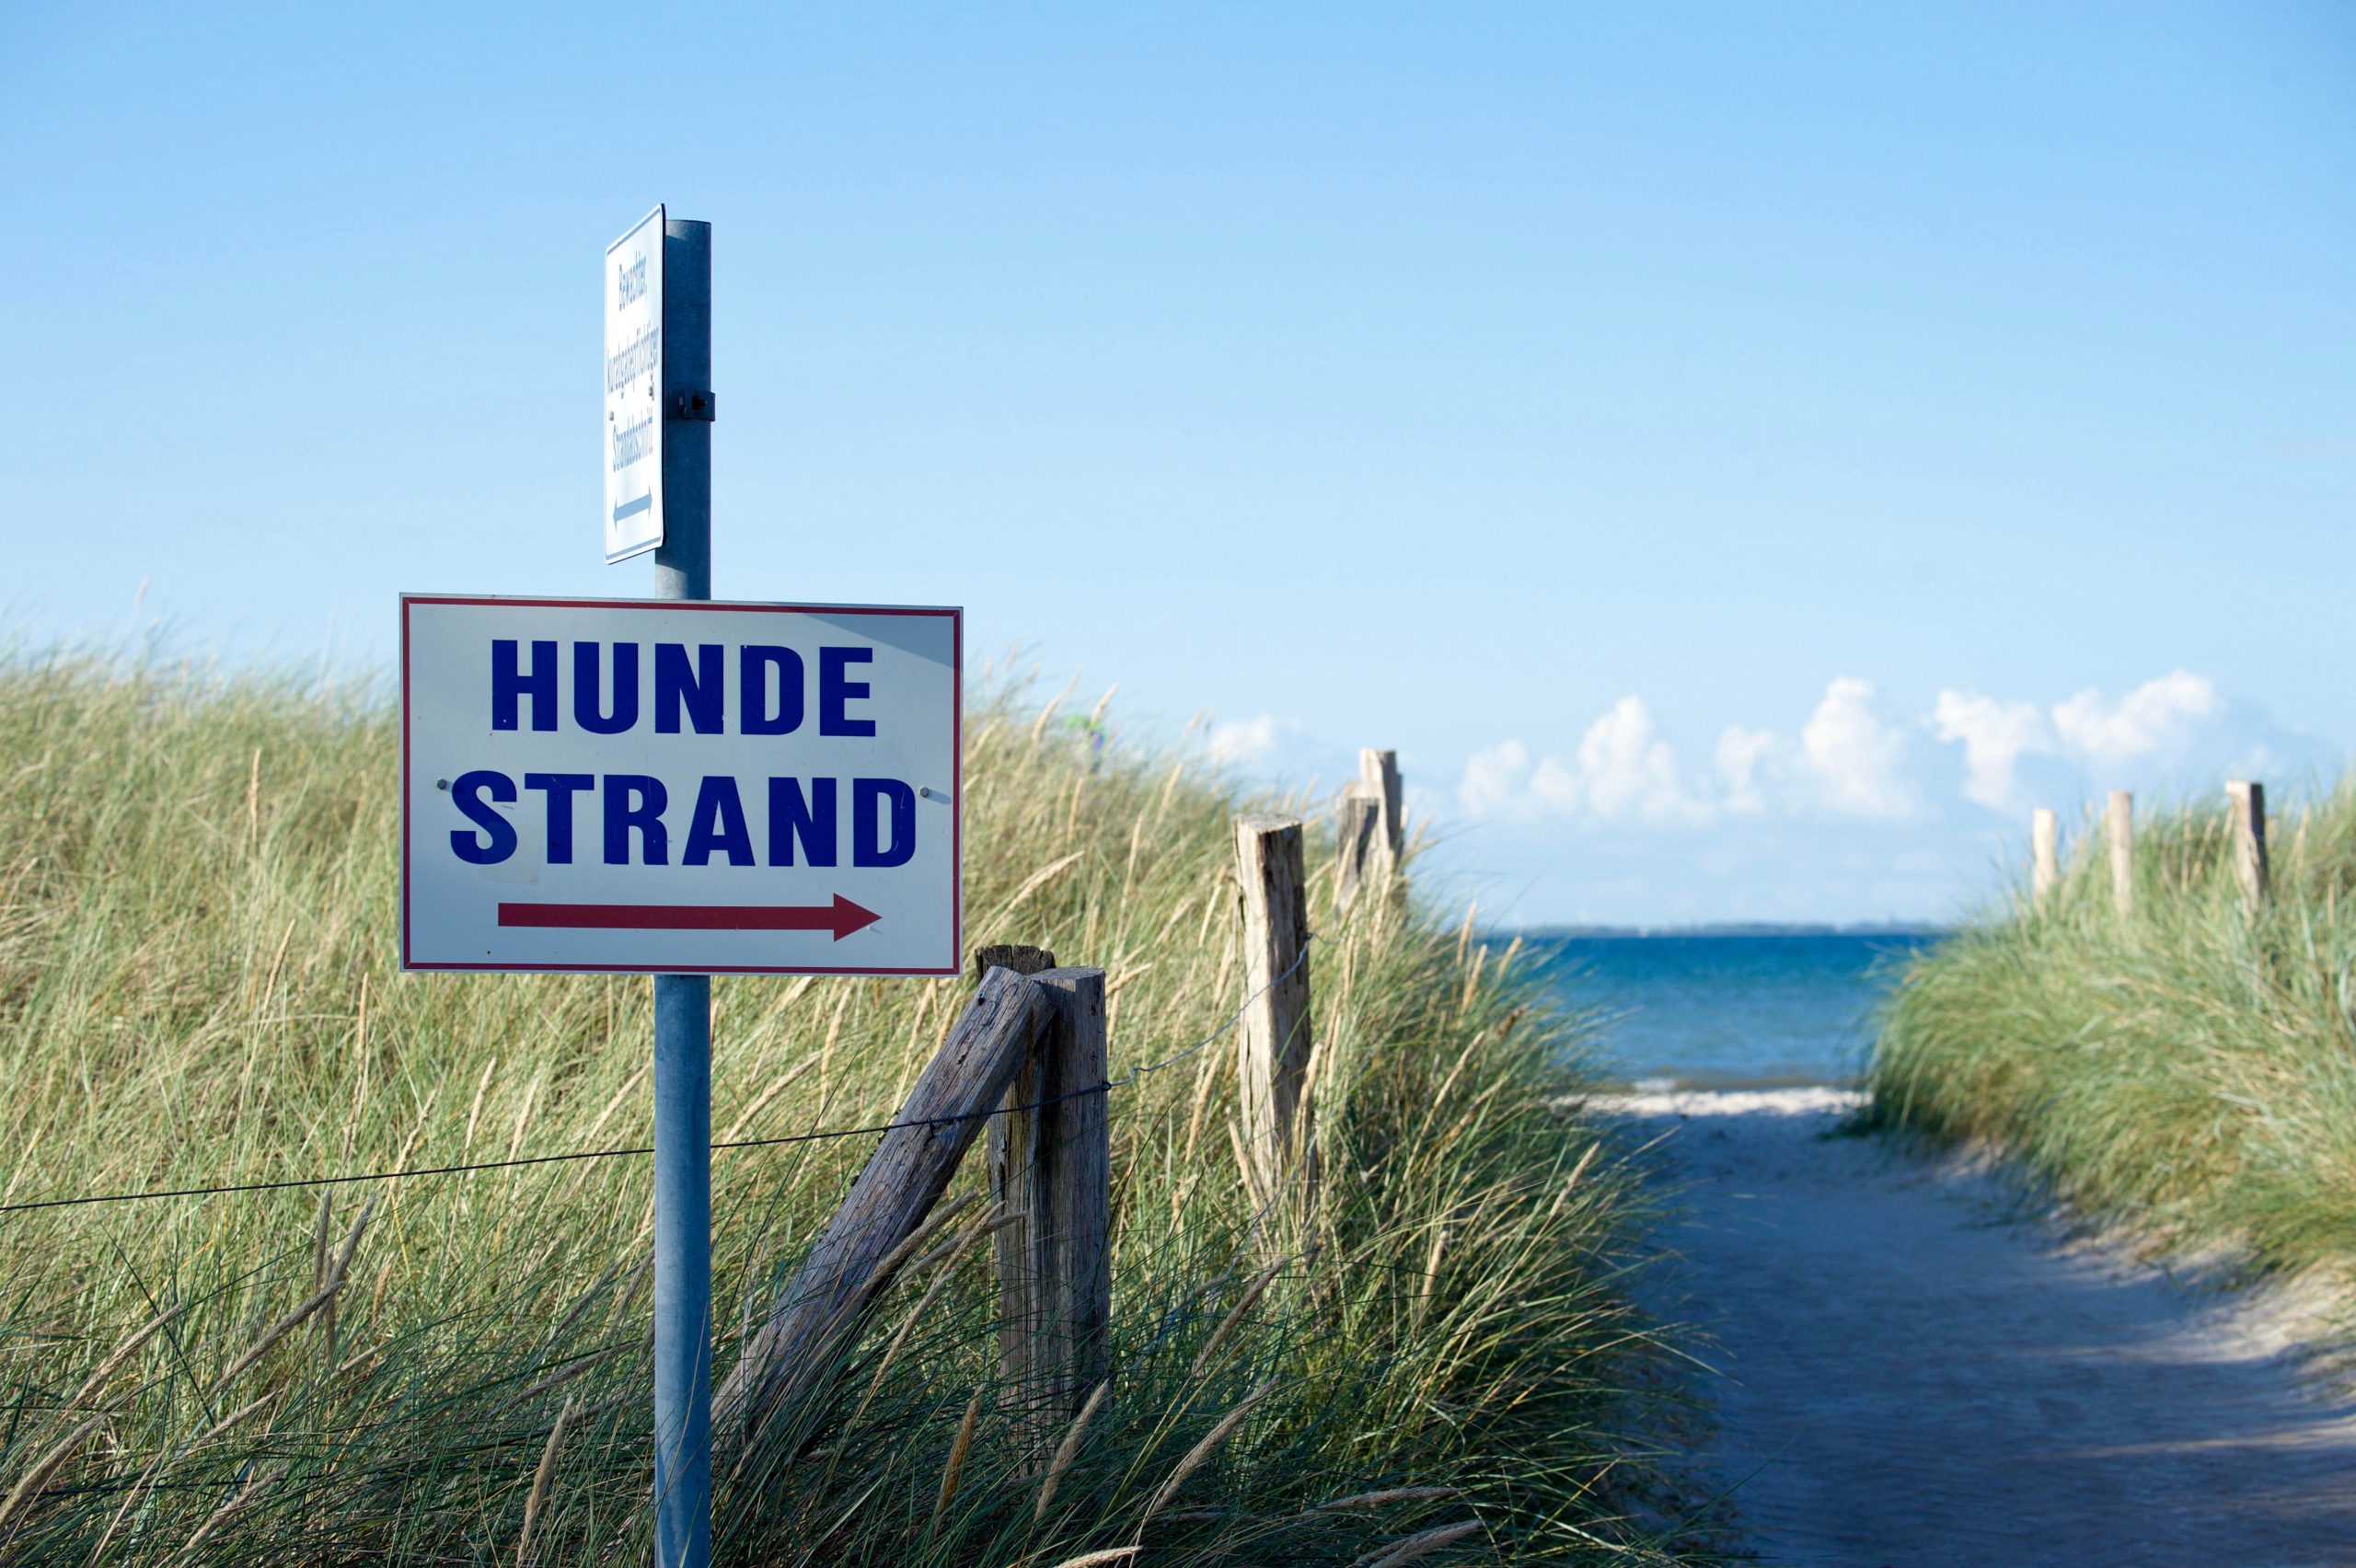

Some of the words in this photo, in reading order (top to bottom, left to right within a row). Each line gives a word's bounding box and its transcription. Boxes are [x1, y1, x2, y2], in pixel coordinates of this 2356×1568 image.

[613, 406, 653, 473] Strandabschnitt
[491, 639, 876, 737] HUNDE
[449, 769, 917, 868] STRAND
